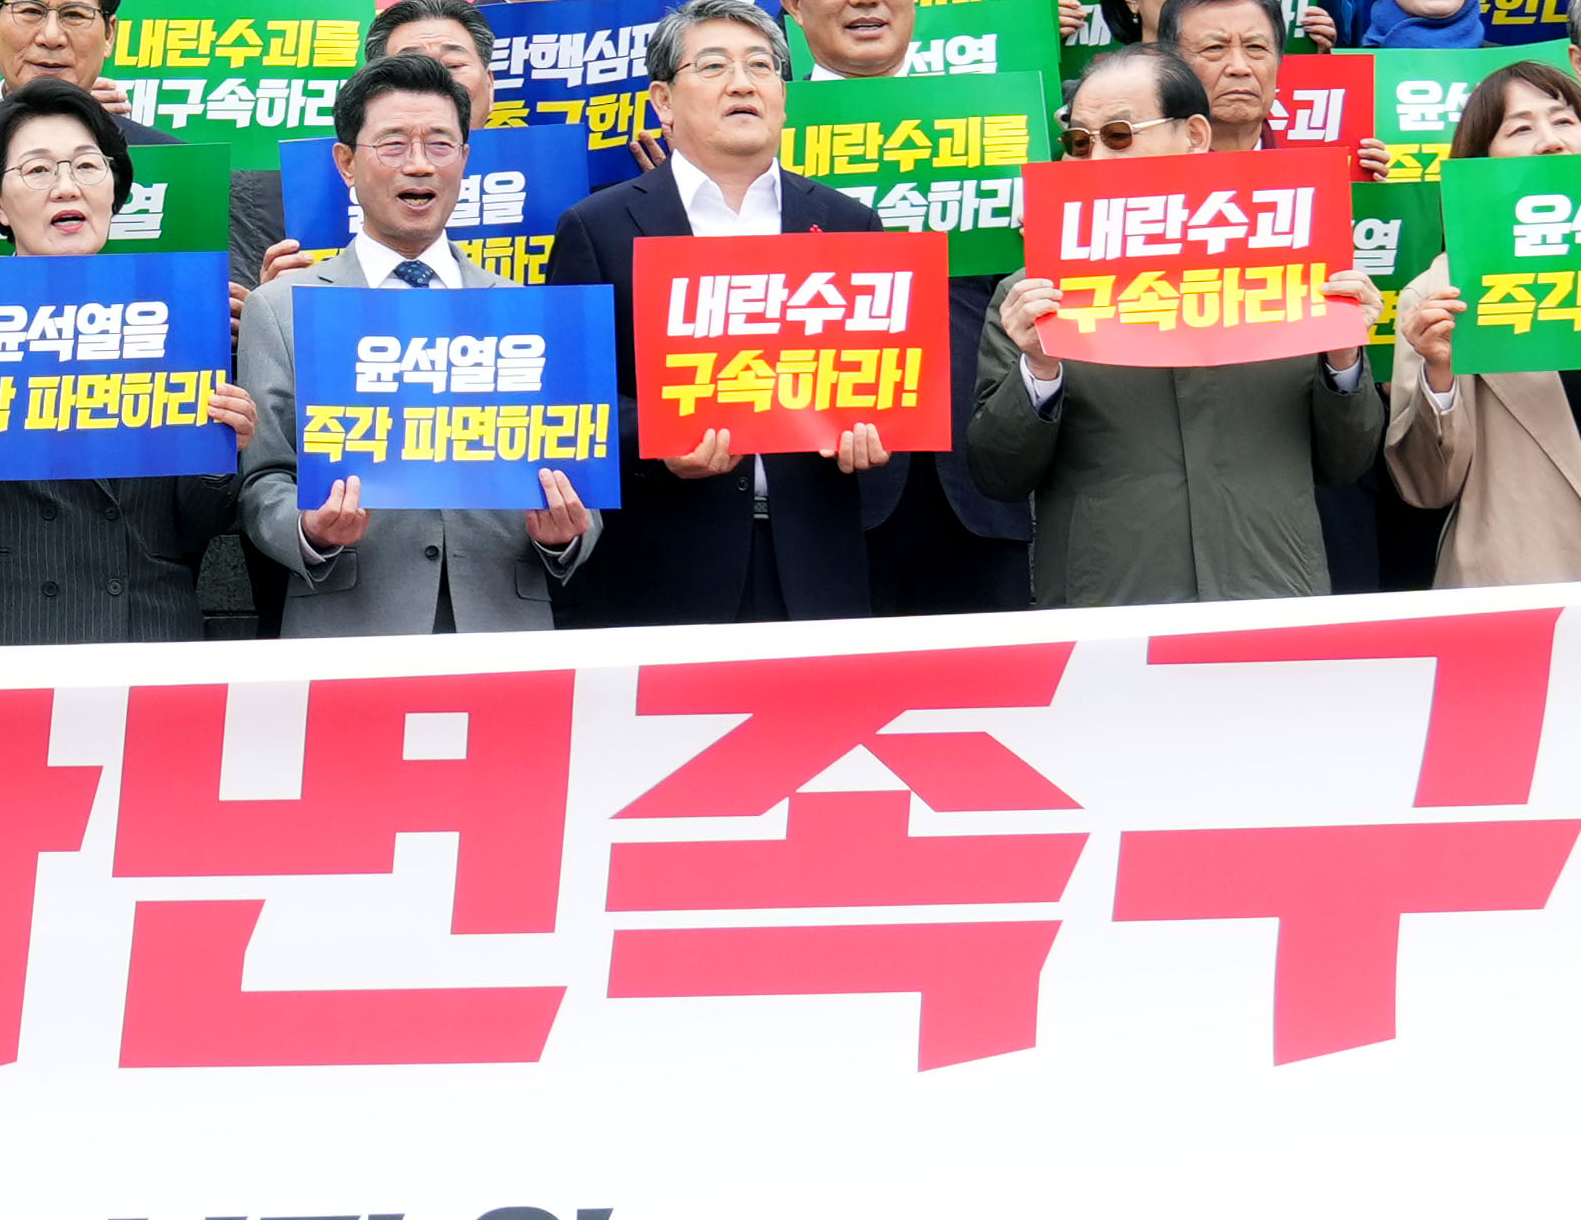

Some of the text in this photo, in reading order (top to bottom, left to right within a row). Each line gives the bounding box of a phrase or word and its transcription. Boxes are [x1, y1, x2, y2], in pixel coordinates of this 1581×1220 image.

[117, 18, 360, 71] 내란수괴를
[781, 121, 1029, 176] 내란수괴를
[1060, 188, 1315, 261] 내란수괴
[667, 271, 912, 338] 내란수괴
[1059, 265, 1326, 334] 구속하라!
[356, 334, 547, 394] 윤석열을
[663, 347, 920, 417] 구속하라!
[303, 402, 608, 461] 즉각 파면하라!
